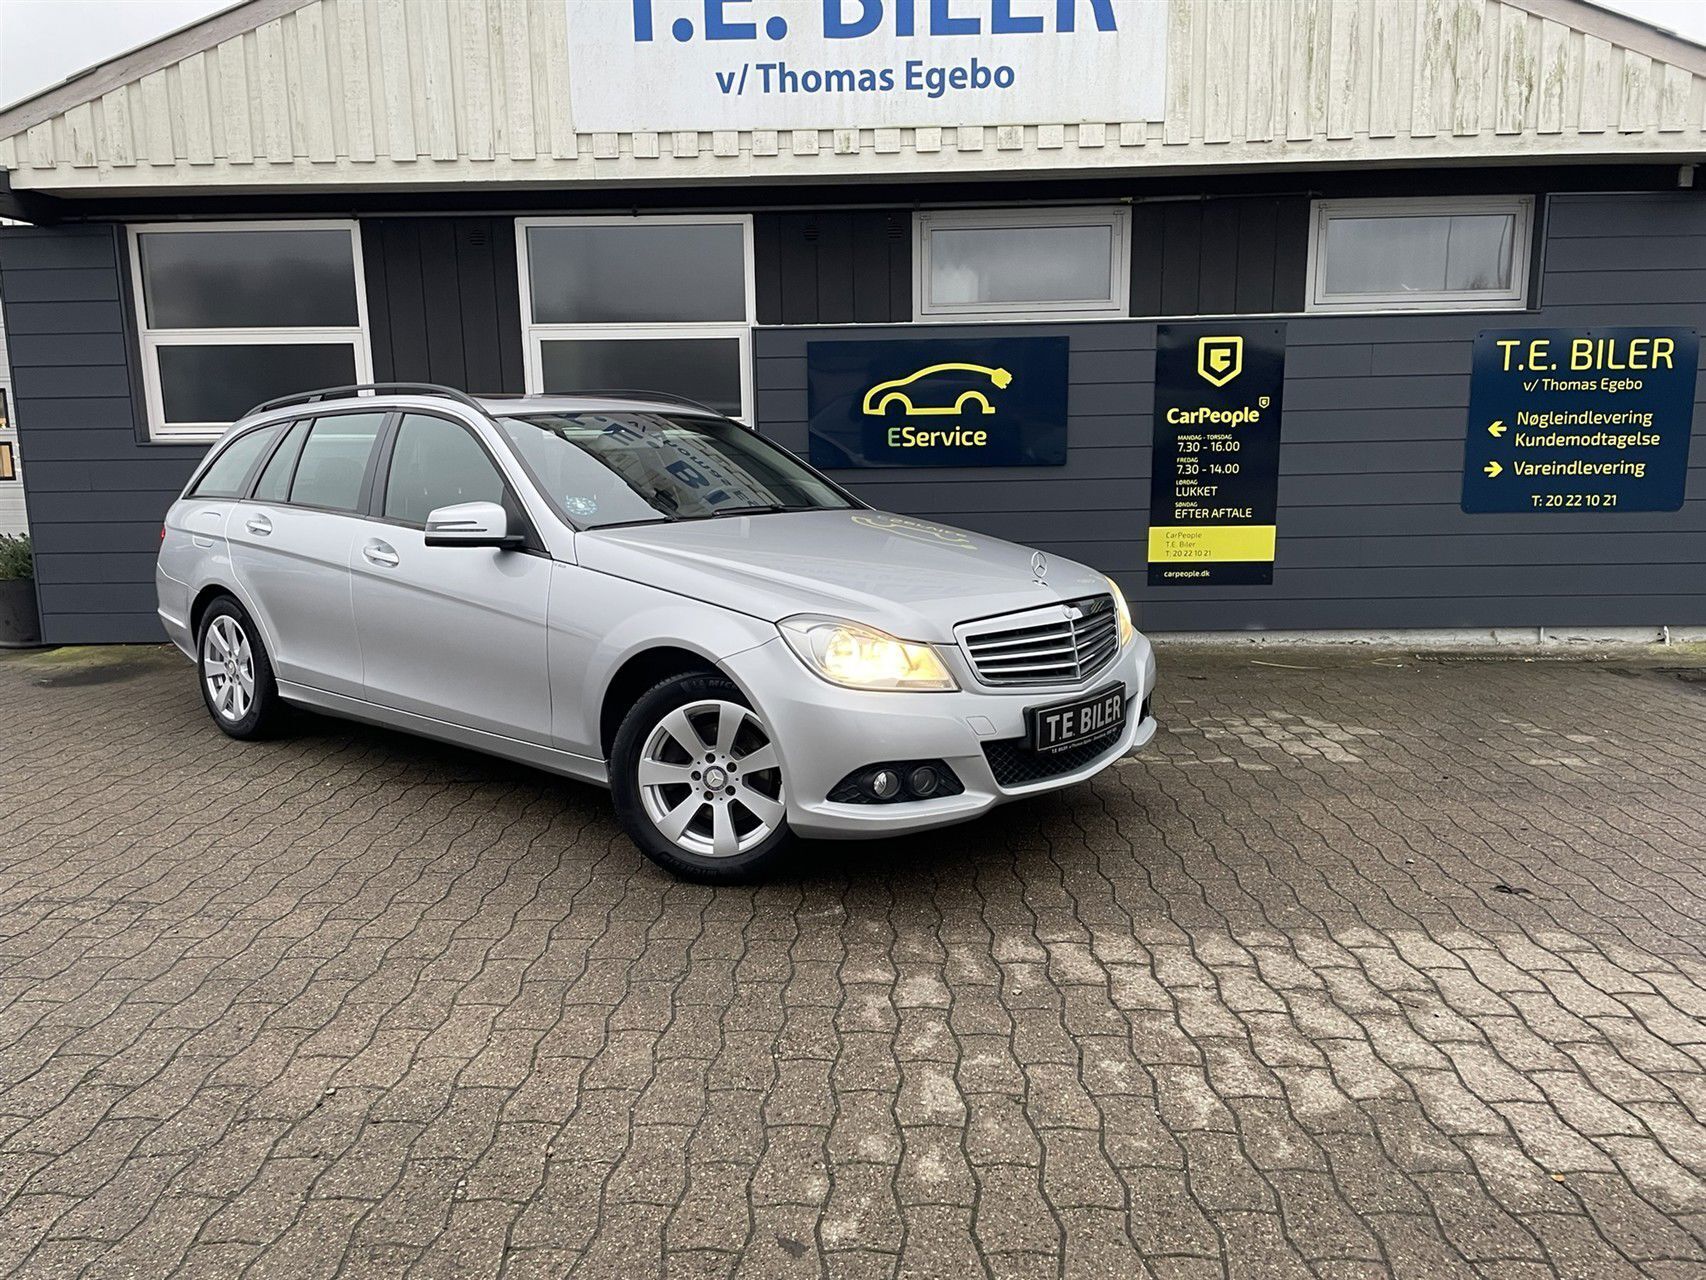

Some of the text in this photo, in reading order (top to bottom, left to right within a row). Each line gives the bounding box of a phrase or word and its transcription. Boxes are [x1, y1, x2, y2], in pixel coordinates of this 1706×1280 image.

[715, 57, 1015, 99] v/ Thomas Egebo
[1496, 338, 1675, 371] T.E. BILER
[1523, 378, 1643, 392] v/ Thomas Egebo
[1167, 407, 1260, 428] CarPeople
[1517, 410, 1653, 428] Nøgleindlevering
[887, 426, 988, 447] EService
[1515, 432, 1660, 449] Kundemodtagelse
[1178, 442, 1200, 452] 7.30
[1211, 441, 1240, 451] 16.00
[1177, 464, 1199, 474] 7.30
[1210, 464, 1239, 474] 14.00
[1514, 460, 1645, 477] Vareindlevering
[1176, 486, 1218, 496] LUKKET
[1532, 495, 1617, 506] T: 20 22 10 21
[1175, 508, 1252, 518] EFTER AFTALE
[1164, 570, 1210, 578] carpeople.dk
[1046, 712, 1075, 742] T.E.
[1080, 696, 1120, 734] BILER
